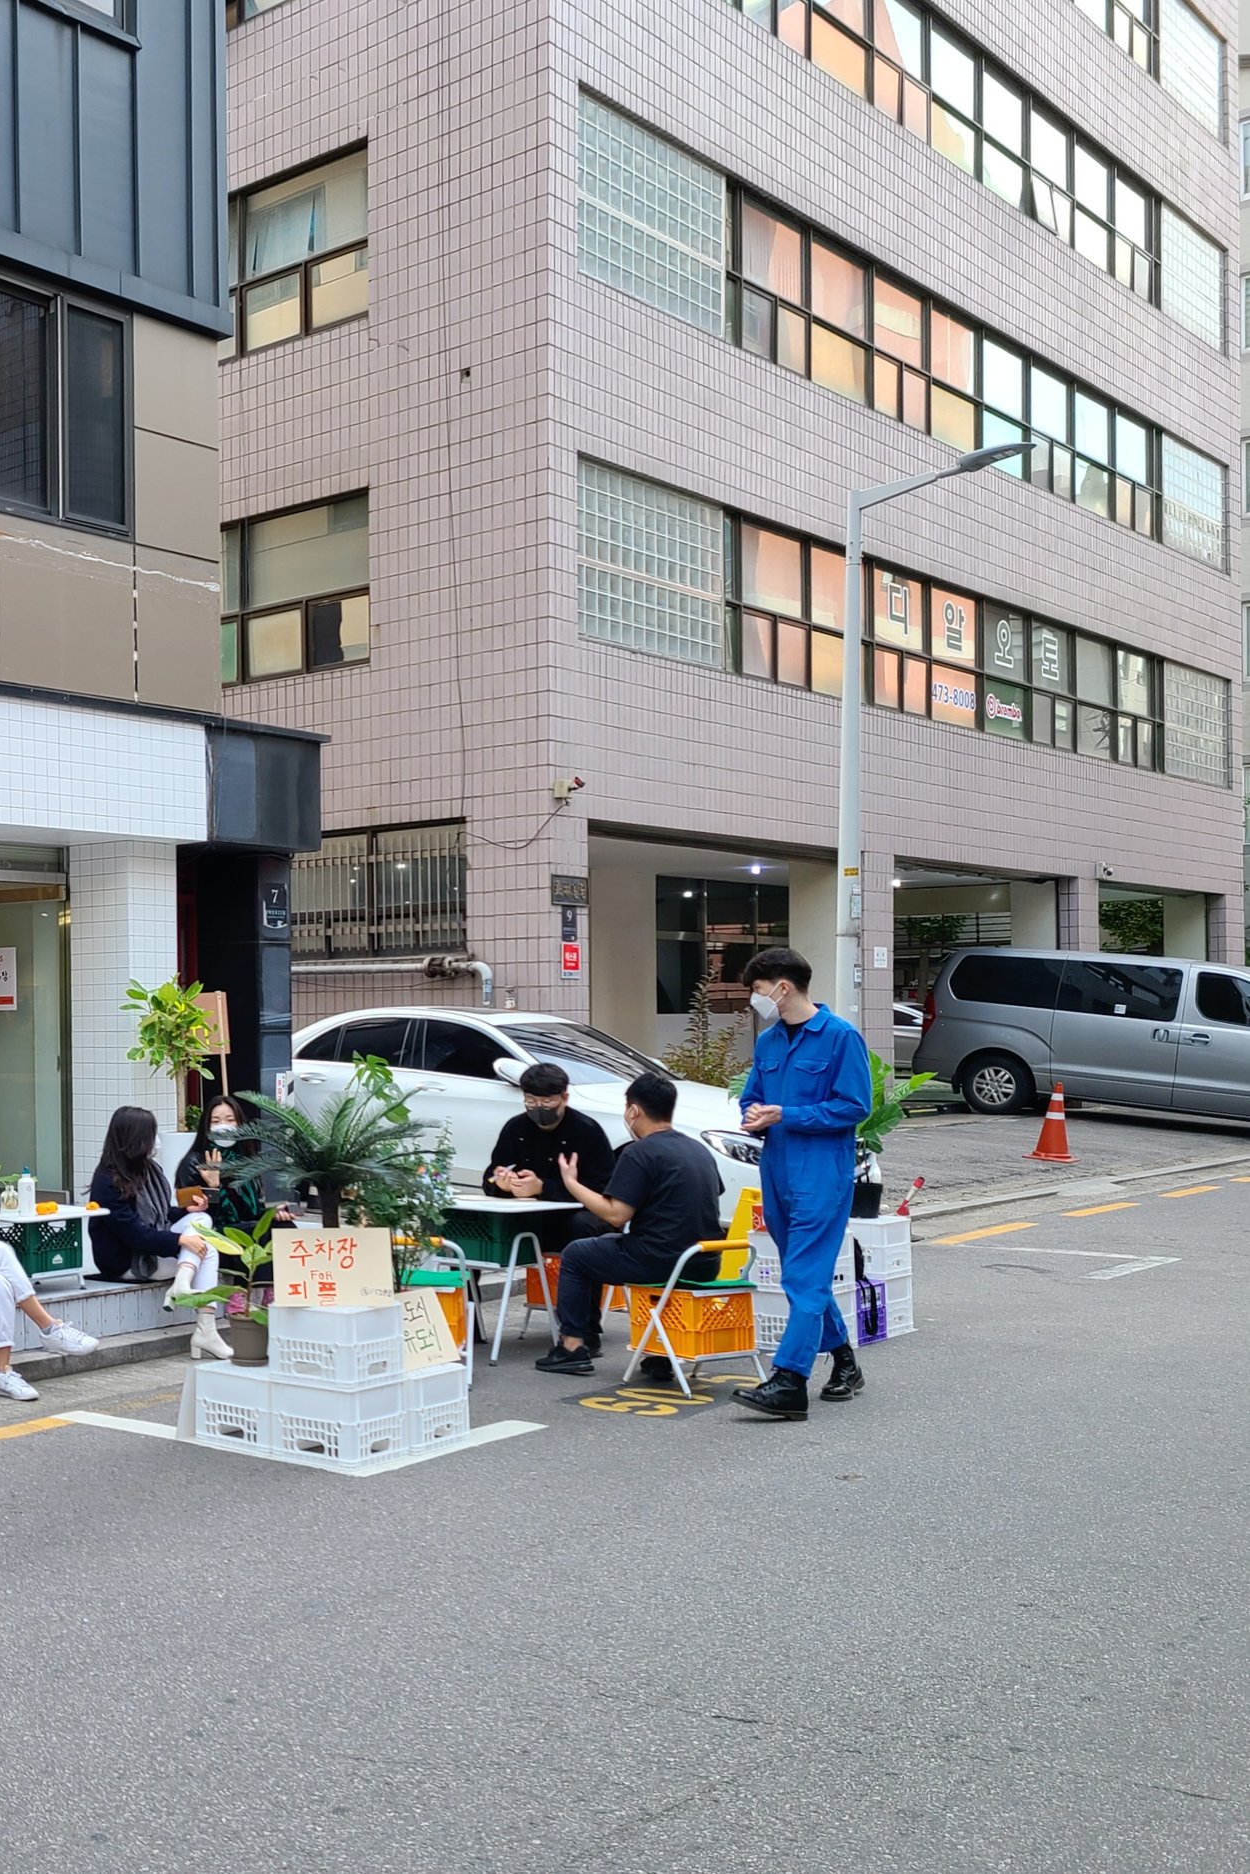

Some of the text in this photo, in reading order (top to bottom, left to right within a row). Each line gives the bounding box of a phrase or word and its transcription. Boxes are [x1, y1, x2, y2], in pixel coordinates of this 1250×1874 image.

[271, 889, 279, 903] 7
[566, 910, 573, 921] 9
[288, 1237, 358, 1270] 주차장
[310, 1269, 334, 1281] FOR
